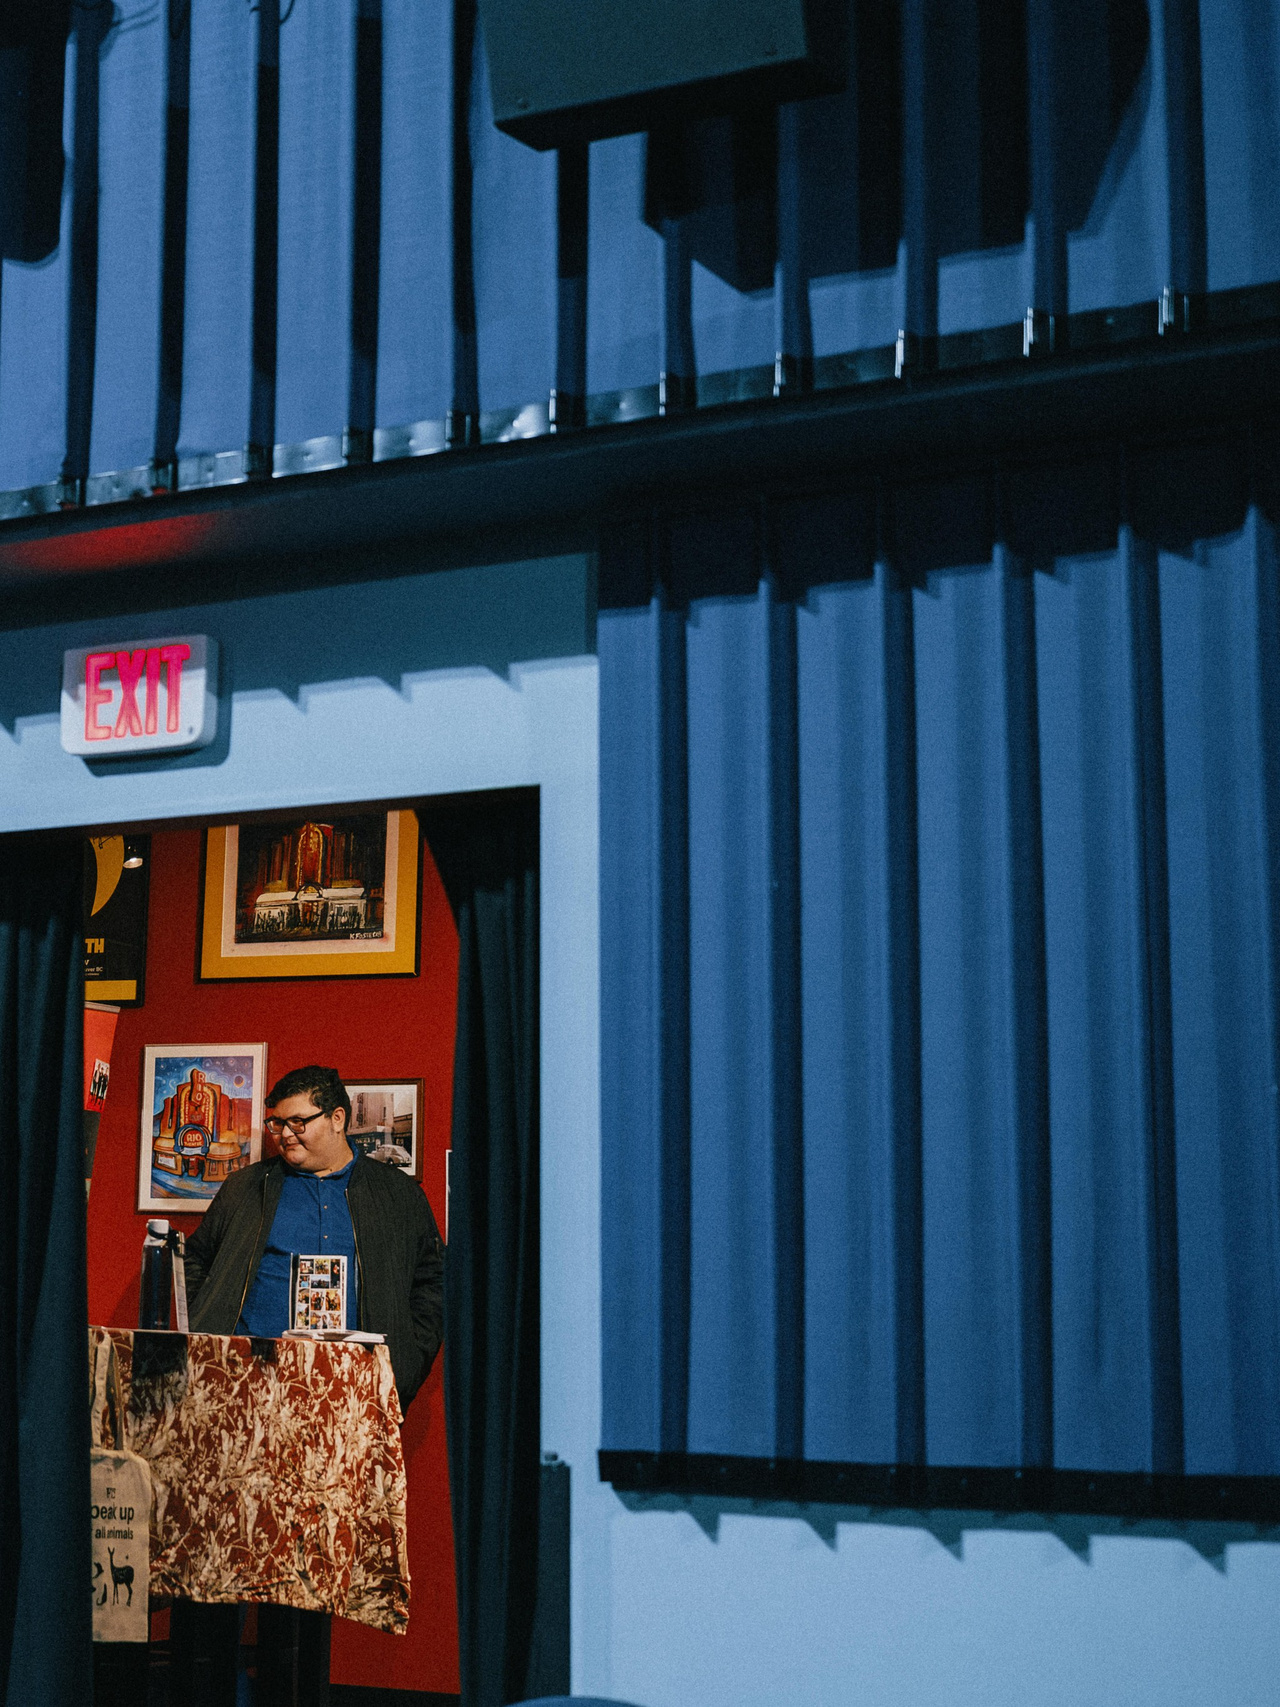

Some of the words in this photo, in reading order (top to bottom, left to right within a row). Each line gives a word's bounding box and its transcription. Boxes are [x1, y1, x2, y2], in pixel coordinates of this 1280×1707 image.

[85, 644, 190, 741] EXIT
[84, 938, 105, 953] TH
[186, 1133, 202, 1142] RIO
[120, 1506, 135, 1525] up
[95, 1526, 106, 1539] all
[106, 1526, 134, 1540] animals
